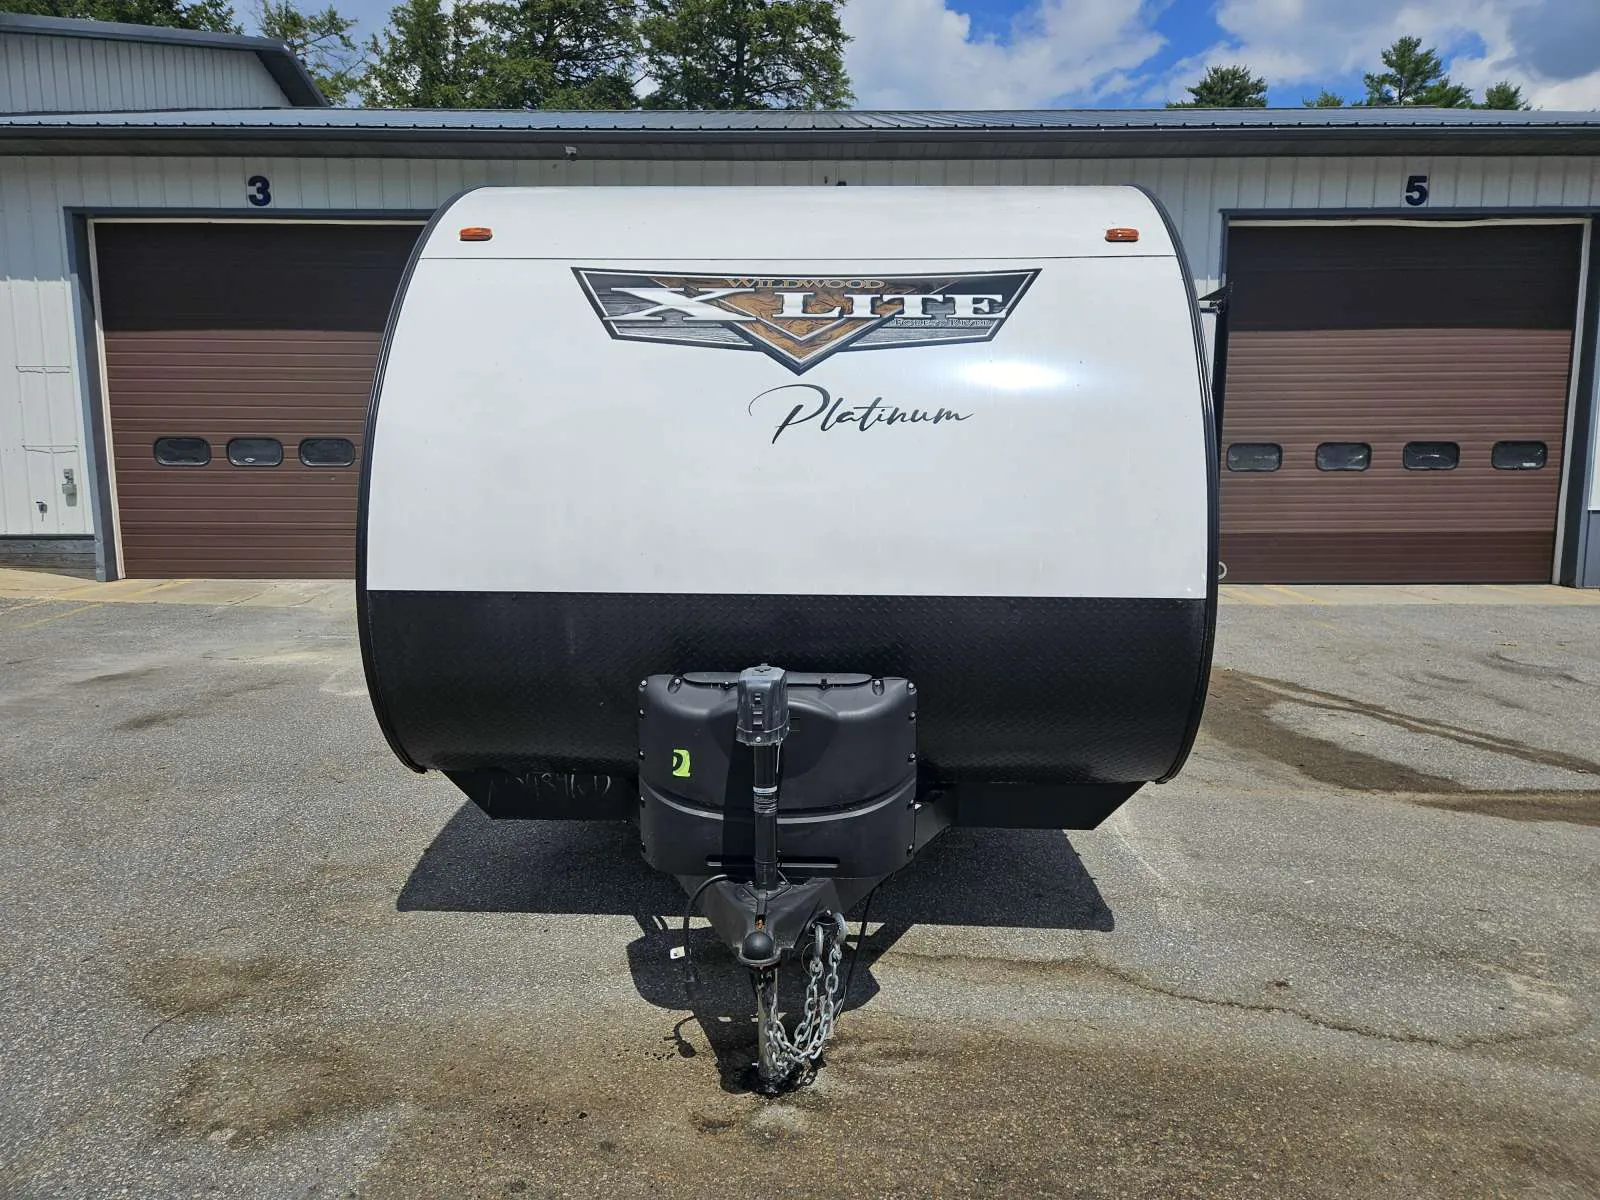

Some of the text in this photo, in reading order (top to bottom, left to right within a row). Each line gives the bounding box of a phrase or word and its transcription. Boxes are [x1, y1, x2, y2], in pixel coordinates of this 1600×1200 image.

[247, 174, 272, 207] 3
[1404, 170, 1432, 207] 5
[727, 278, 886, 289] WILDWOOD
[602, 286, 1006, 322] X LITE
[748, 383, 974, 445] Platinum
